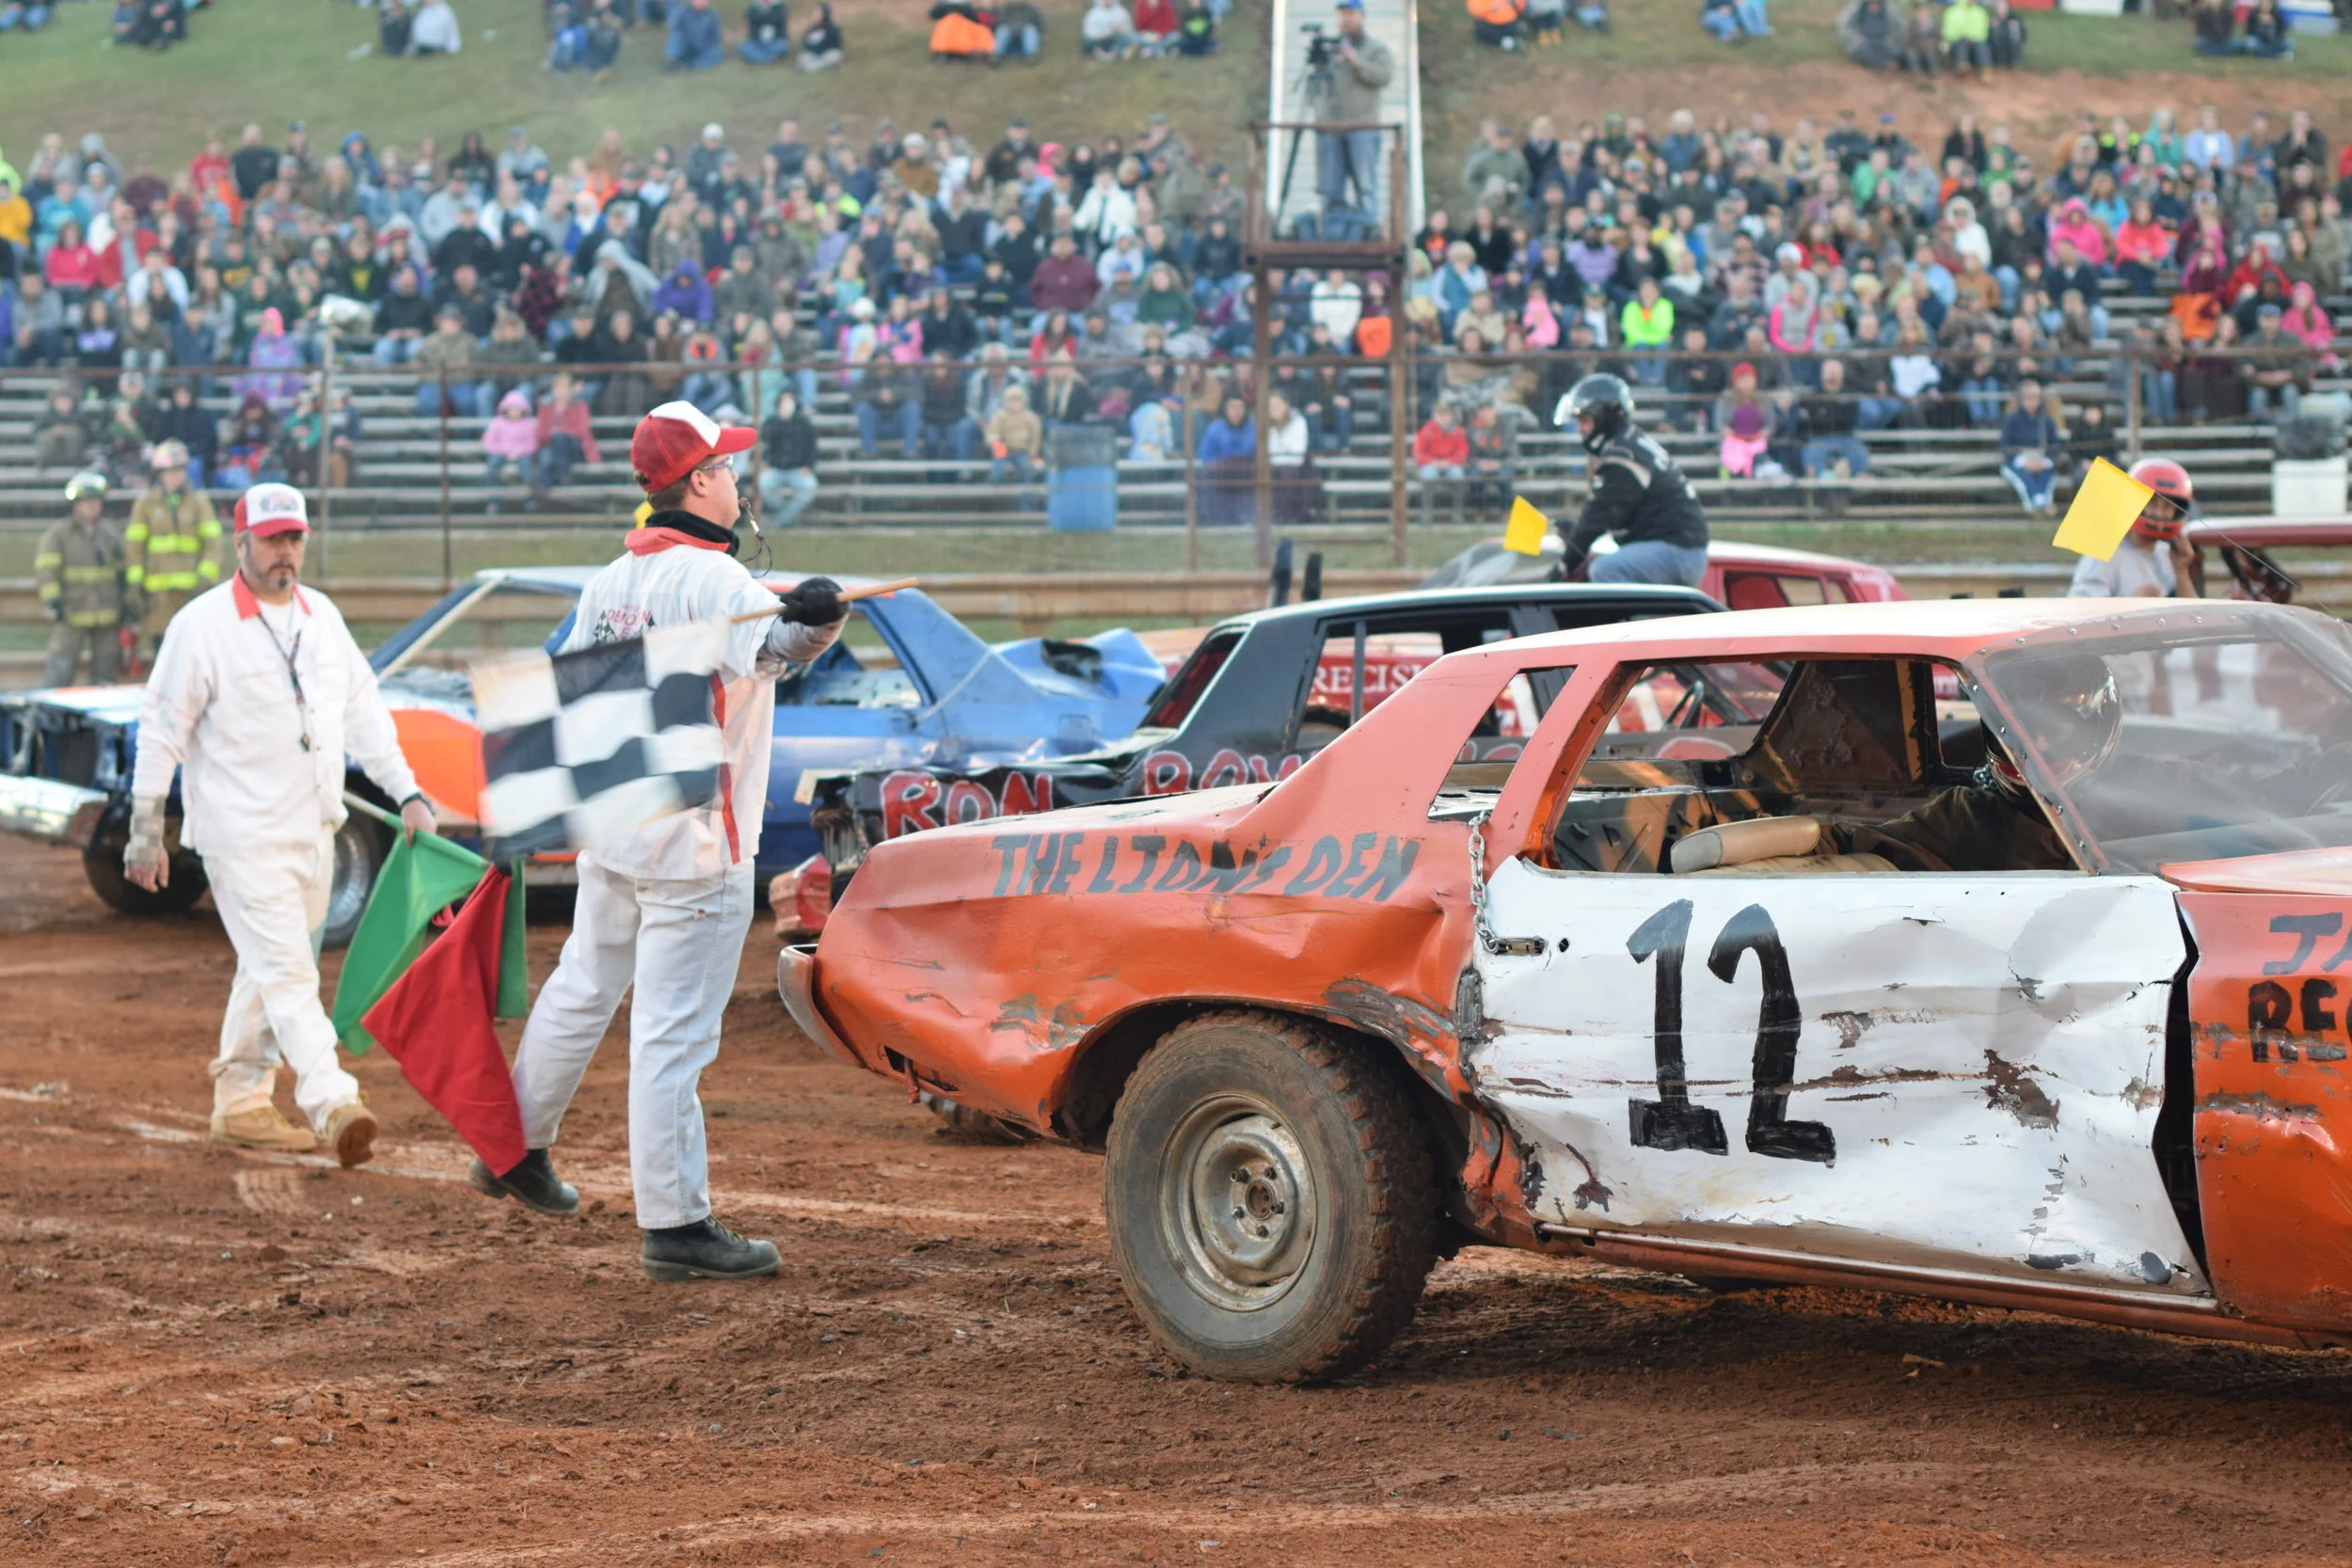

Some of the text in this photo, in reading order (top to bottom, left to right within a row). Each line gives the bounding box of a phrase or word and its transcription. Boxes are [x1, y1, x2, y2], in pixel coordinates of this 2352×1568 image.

[1311, 664, 1422, 693] RECIS
[881, 768, 1054, 840] RON
[992, 832, 1085, 896] THE
[1283, 832, 1421, 902] DEN
[1626, 898, 1836, 1168] 12
[2249, 979, 2352, 1063] RE
